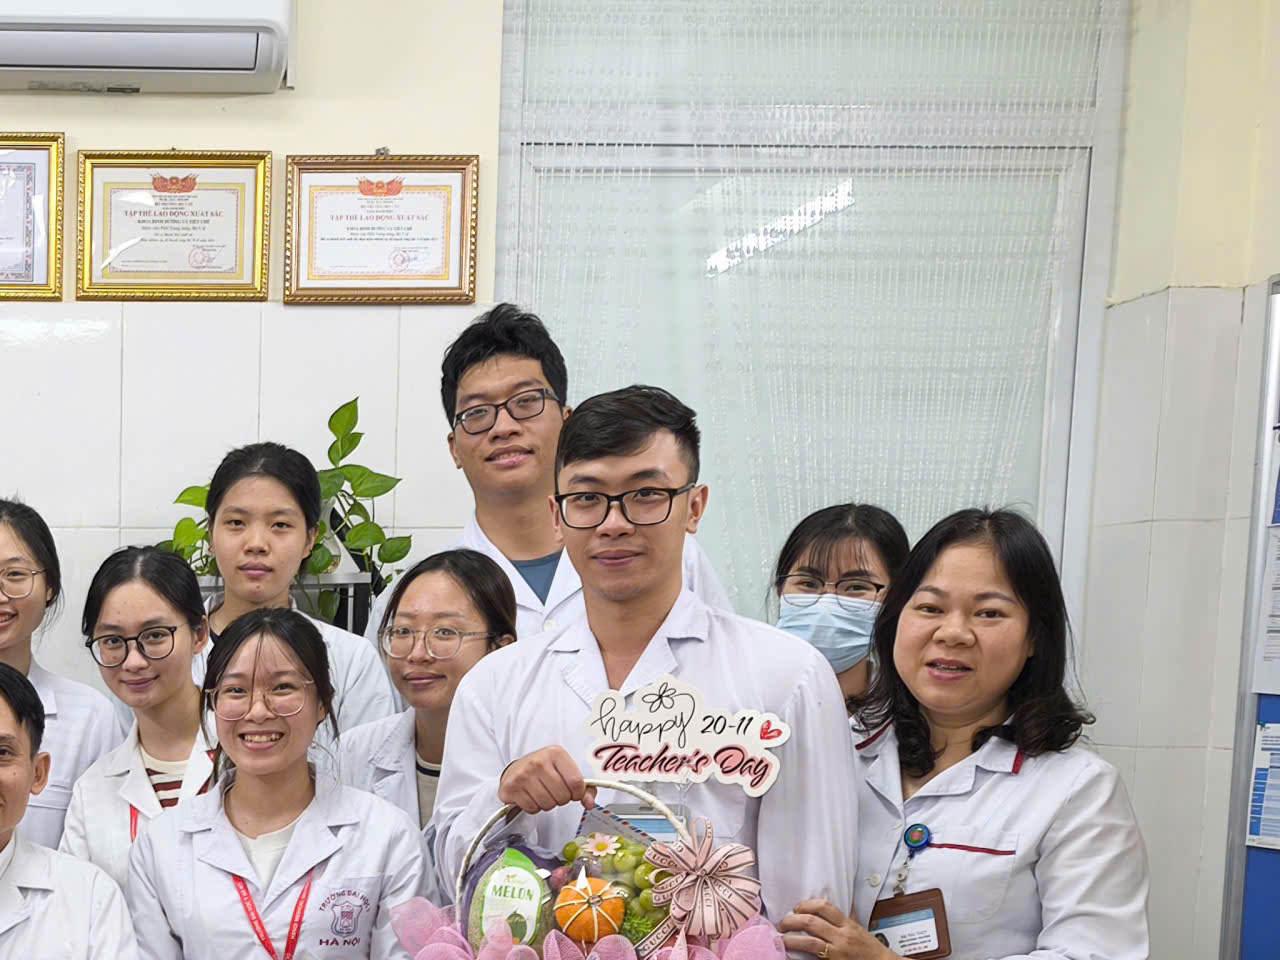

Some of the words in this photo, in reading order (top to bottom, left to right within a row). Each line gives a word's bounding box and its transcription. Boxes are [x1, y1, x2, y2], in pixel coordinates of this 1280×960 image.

[590, 693, 695, 749] happy
[701, 715, 754, 736] 20-11
[593, 742, 710, 774] Teacher's
[713, 746, 770, 788] Day
[492, 885, 534, 901] MELON
[641, 923, 671, 952] GUCCI
